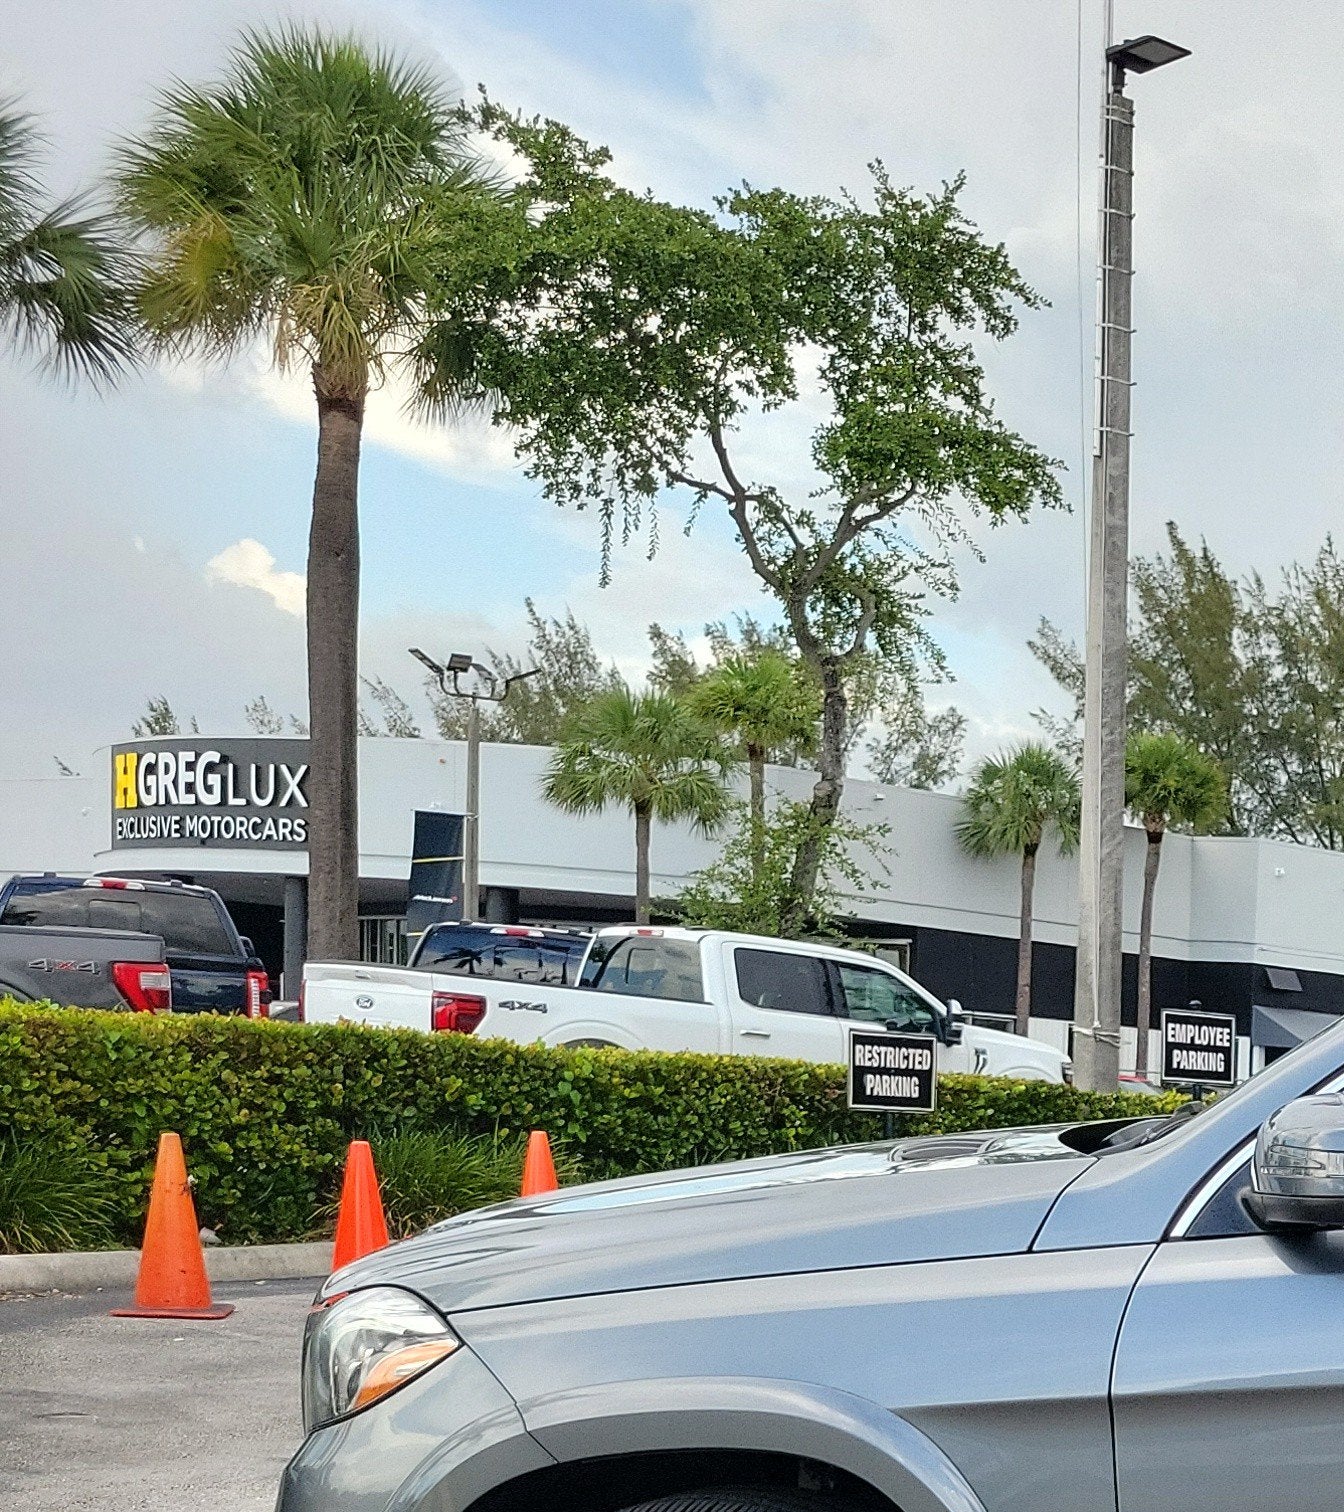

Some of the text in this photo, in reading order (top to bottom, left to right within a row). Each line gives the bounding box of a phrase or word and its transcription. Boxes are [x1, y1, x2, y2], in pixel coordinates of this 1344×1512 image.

[116, 815, 307, 842] EXCLUSIVE MOTORCARS
[1167, 1022, 1231, 1047] EMPLOYEE
[855, 1044, 931, 1070] RESTRICTED
[1172, 1049, 1225, 1072] PARKING
[866, 1074, 920, 1098] PARKING
